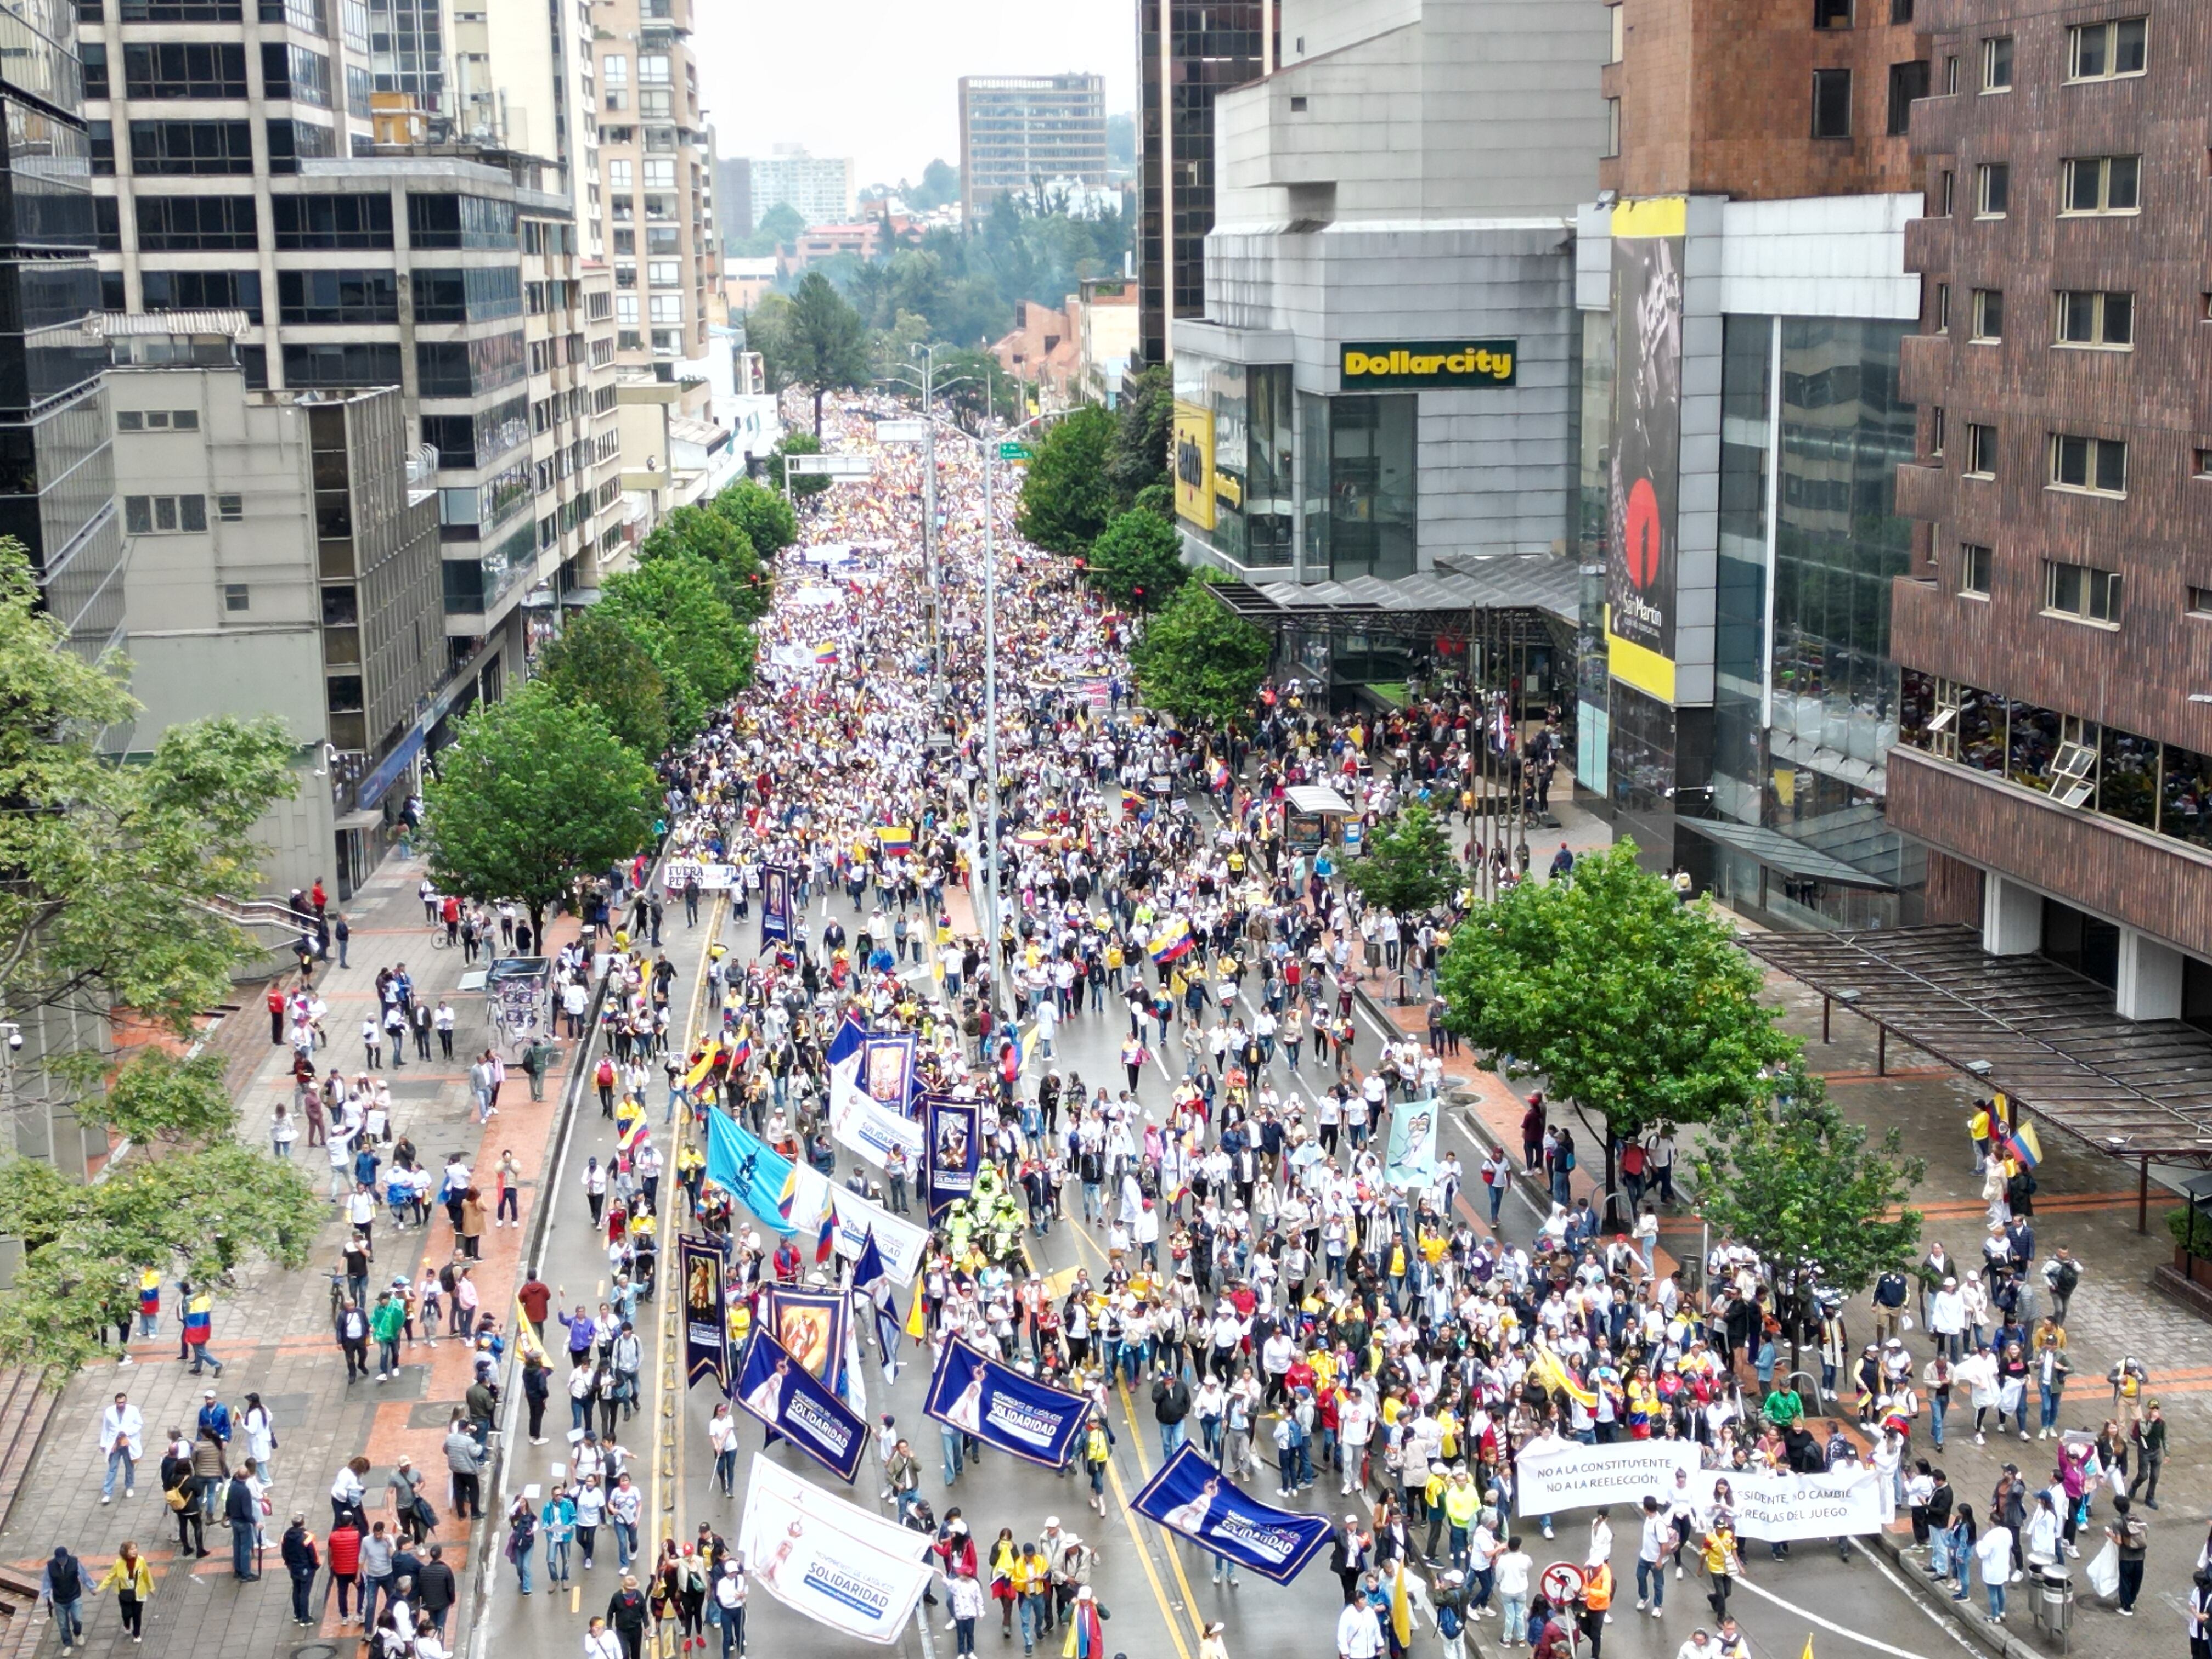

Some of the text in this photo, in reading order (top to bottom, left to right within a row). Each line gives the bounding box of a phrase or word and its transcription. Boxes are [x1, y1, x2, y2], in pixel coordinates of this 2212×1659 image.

[1346, 348, 1511, 378] Dollarcity
[791, 1398, 848, 1448] SOLIDARIDAD
[992, 1402, 1057, 1436] SOLIDARIDAD
[1538, 1468, 1553, 1478] NO
[1566, 1464, 1578, 1474] LA
[1547, 1482, 1561, 1492] NO
[1745, 1509, 1784, 1523] REGLAS
[1787, 1510, 1804, 1521] DEL
[808, 1562, 889, 1608] SOLIDARIDAD
